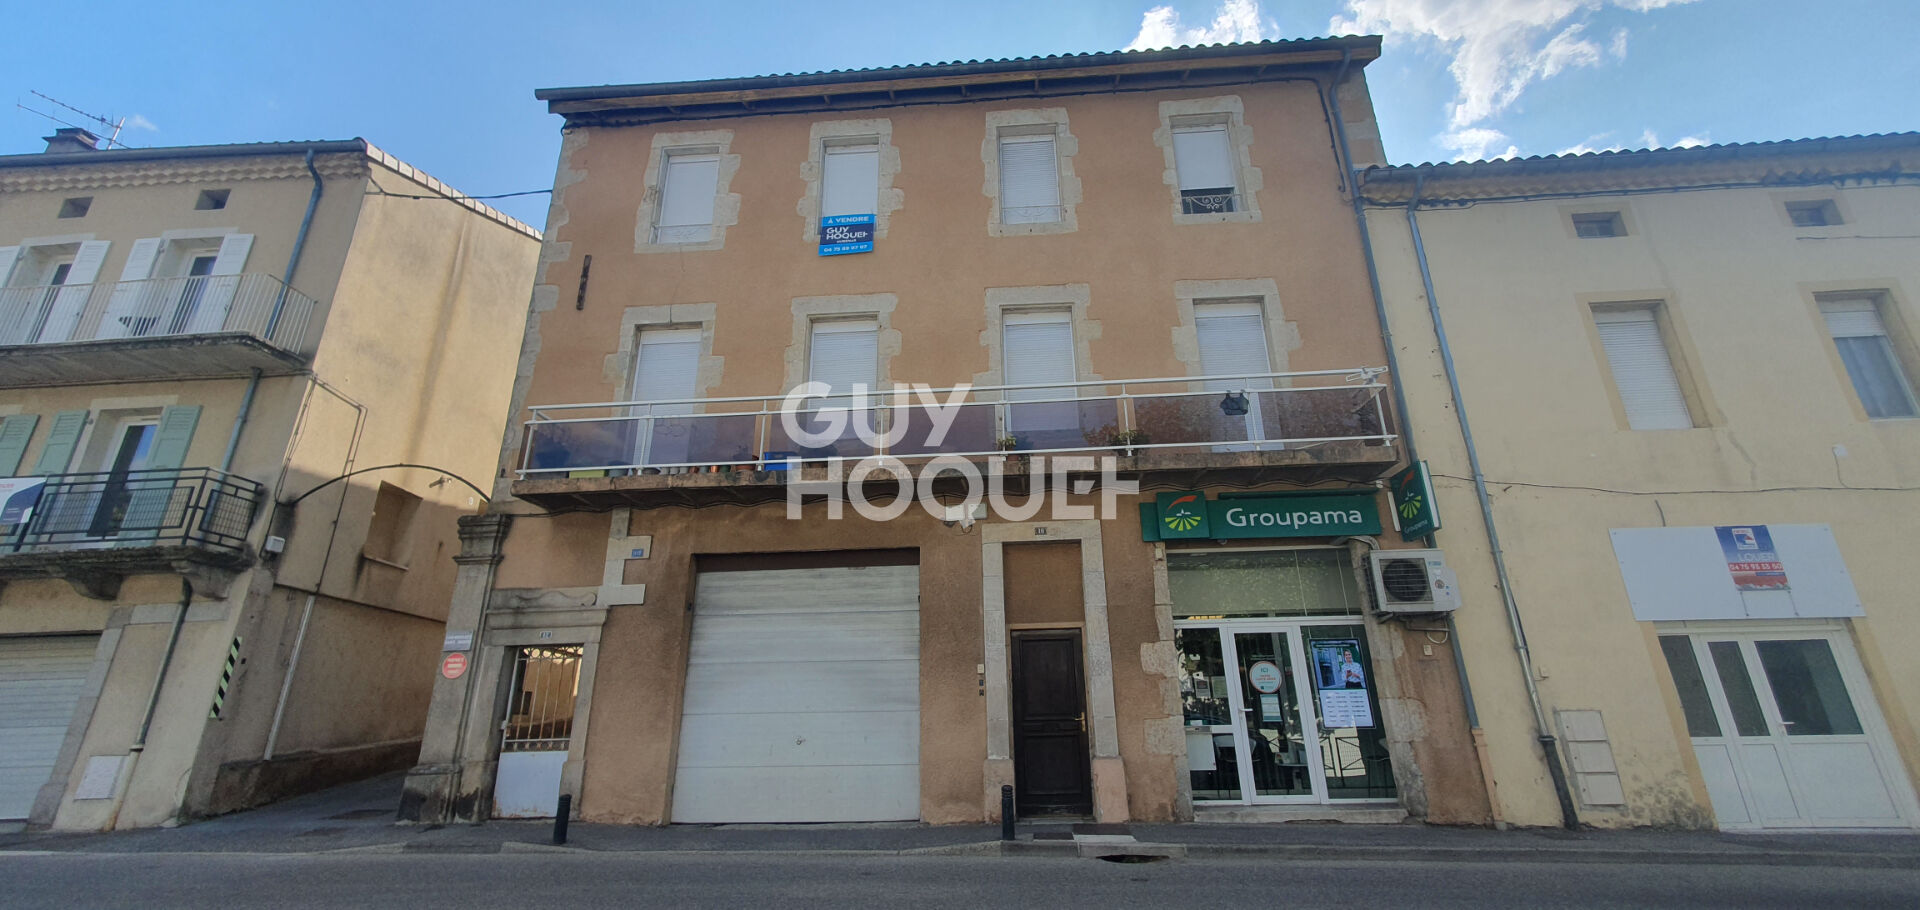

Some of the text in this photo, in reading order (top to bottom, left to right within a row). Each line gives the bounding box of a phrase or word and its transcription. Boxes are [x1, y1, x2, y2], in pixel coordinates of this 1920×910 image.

[826, 226, 849, 234] GUY
[1226, 508, 1363, 529] Groupama
[1403, 519, 1429, 534] Groupama
[1737, 553, 1775, 561] LOUER
